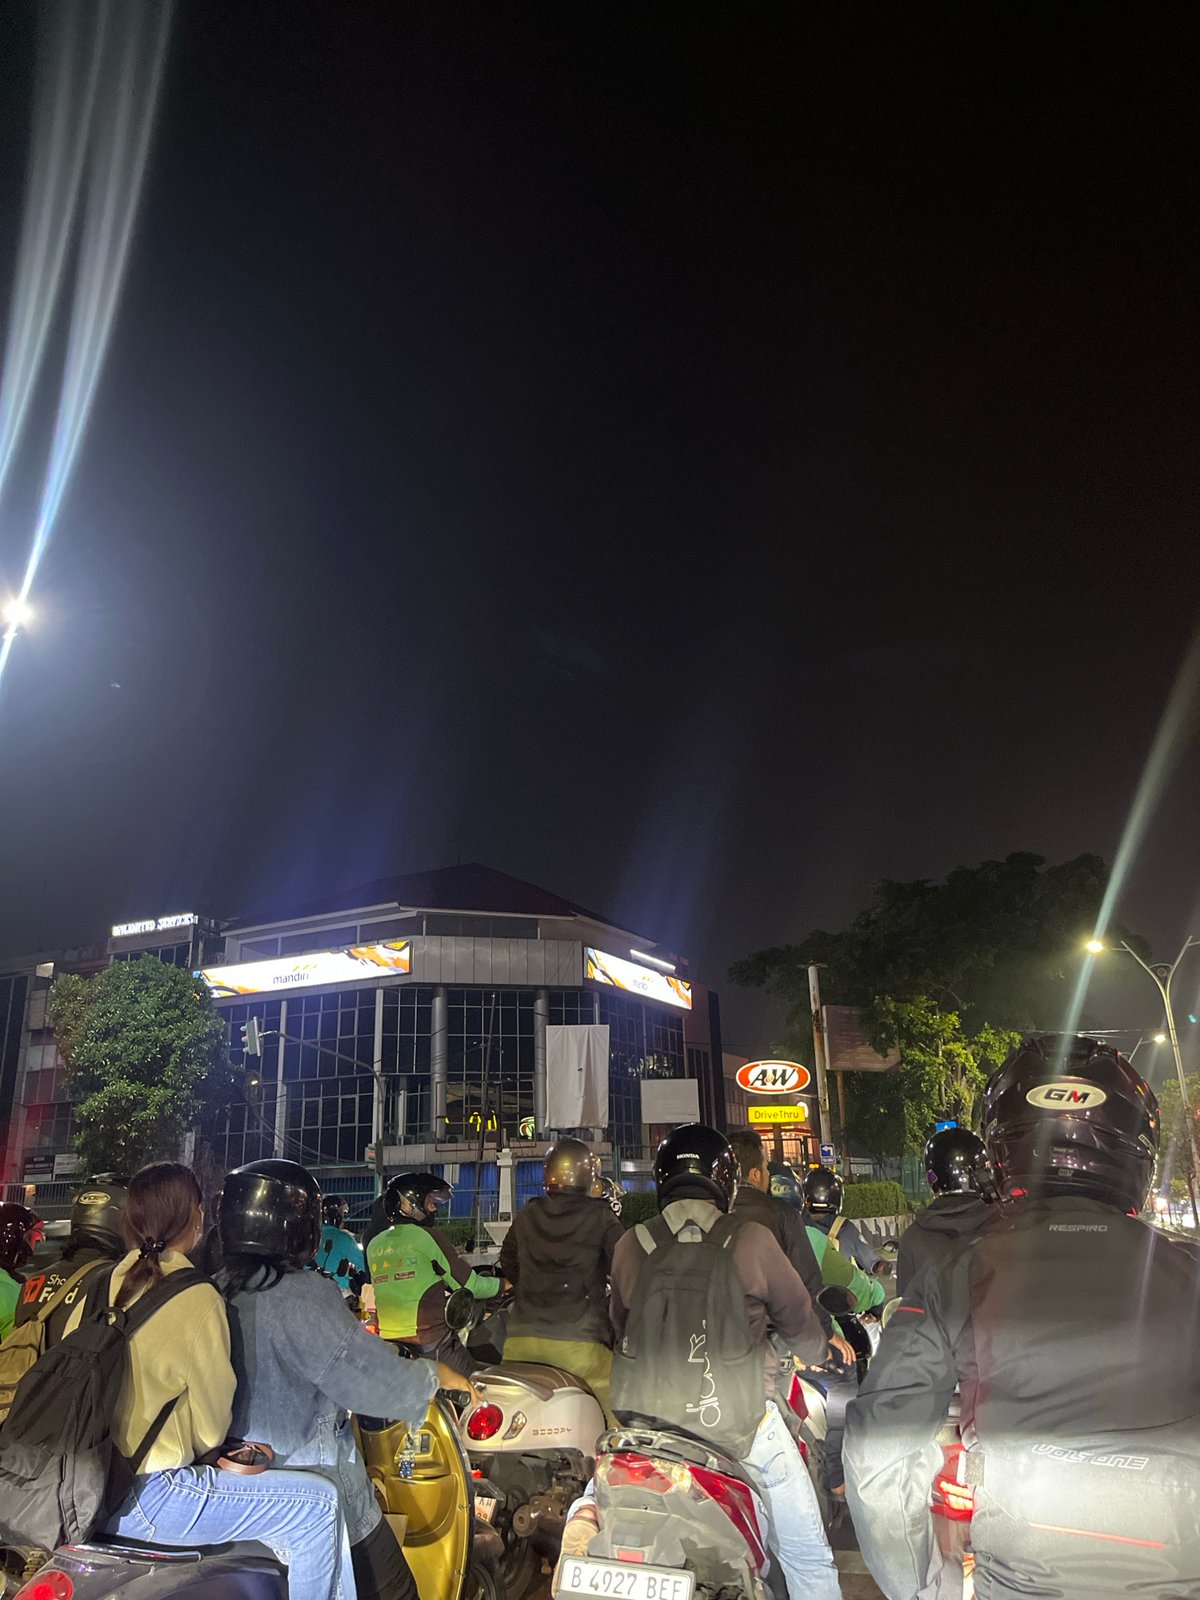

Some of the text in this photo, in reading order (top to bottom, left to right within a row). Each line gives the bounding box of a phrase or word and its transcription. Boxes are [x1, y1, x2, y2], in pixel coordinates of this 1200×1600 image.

[273, 972, 309, 984] mandiri
[1044, 1088, 1089, 1104] GM
[1049, 1224, 1108, 1232] RESPIRO
[571, 1566, 582, 1588] B
[589, 1569, 638, 1596] 4927
